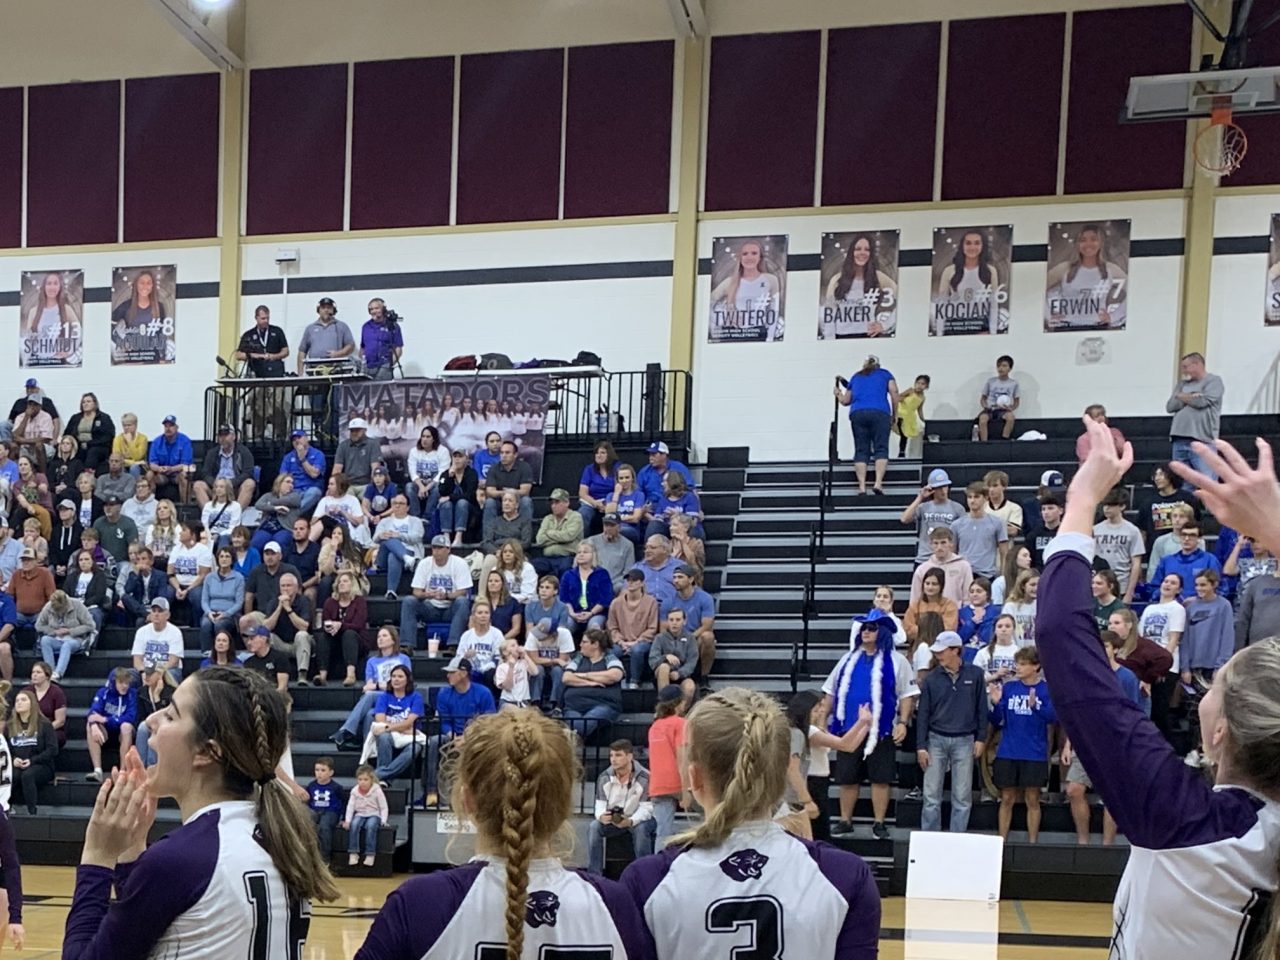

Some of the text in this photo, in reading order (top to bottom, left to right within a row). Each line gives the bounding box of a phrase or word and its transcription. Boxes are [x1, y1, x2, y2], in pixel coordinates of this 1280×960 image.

[864, 287, 894, 307] #3
[974, 283, 1008, 303] #6
[1092, 279, 1126, 299] #7
[824, 305, 871, 323] BAKER
[935, 302, 991, 320] KOCIAN
[1051, 298, 1100, 315] ERWIN
[146, 317, 174, 336] #8
[714, 309, 776, 327] TWITERO
[47, 321, 81, 339] #13
[24, 338, 78, 354] SCHMIDT
[342, 379, 549, 412] MATADORS
[1094, 535, 1128, 545] TAMU
[1008, 698, 1042, 710] BEAS
[0, 750, 11, 786] 2
